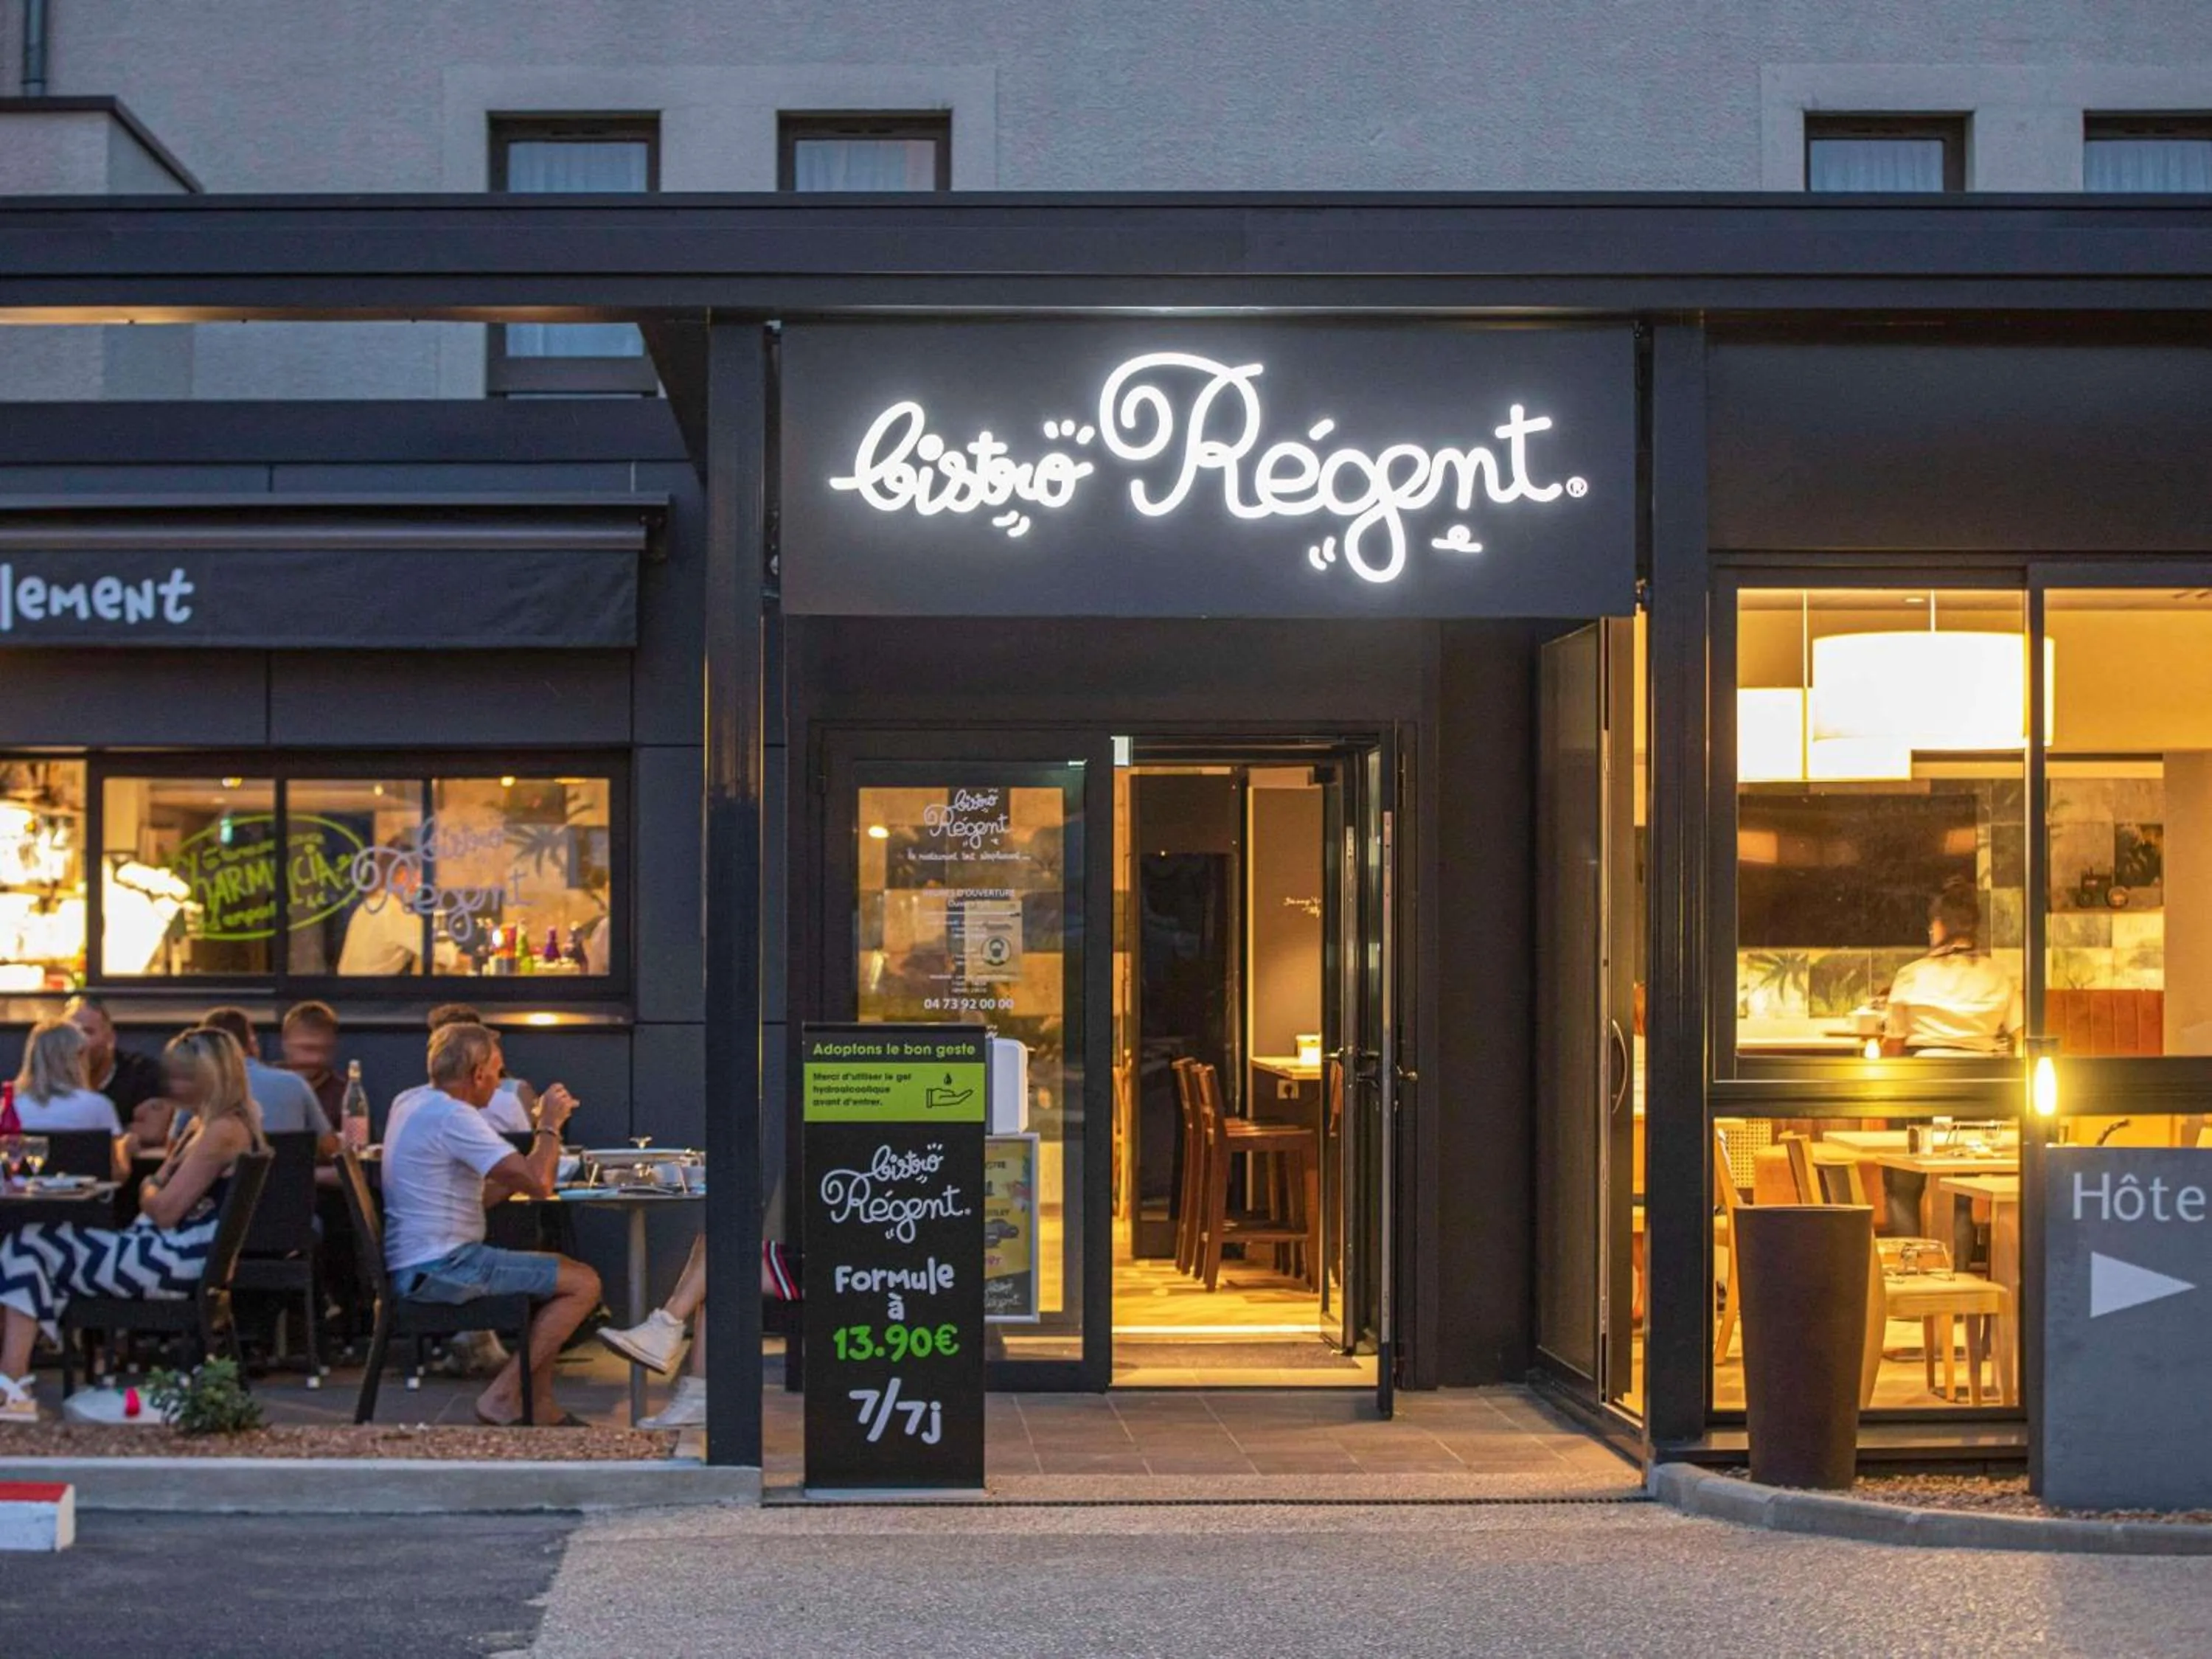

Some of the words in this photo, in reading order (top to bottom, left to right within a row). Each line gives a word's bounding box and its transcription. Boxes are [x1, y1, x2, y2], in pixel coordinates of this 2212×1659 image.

[1099, 352, 1562, 583] Régent
[923, 804, 1013, 849] Régent
[924, 998, 939, 1009] 04
[943, 998, 959, 1009] 73
[961, 998, 977, 1009] 92
[979, 998, 995, 1009] 00
[998, 998, 1015, 1009] 00
[813, 1043, 883, 1057] Adoptons
[886, 1043, 900, 1055] le
[904, 1042, 932, 1055] bon
[936, 1043, 976, 1057] geste
[813, 1085, 891, 1095] hydroalcoolique
[842, 1073, 883, 1081] d'utiliser
[885, 1073, 894, 1081] le
[896, 1073, 912, 1083] gel
[813, 1098, 841, 1107] avant
[821, 1168, 964, 1244] Régent
[2073, 1172, 2207, 1222] Hôte
[835, 1256, 956, 1295] Formule
[887, 1292, 905, 1321] à
[832, 1324, 960, 1363] 13.90€
[848, 1377, 942, 1444] 7/7j
